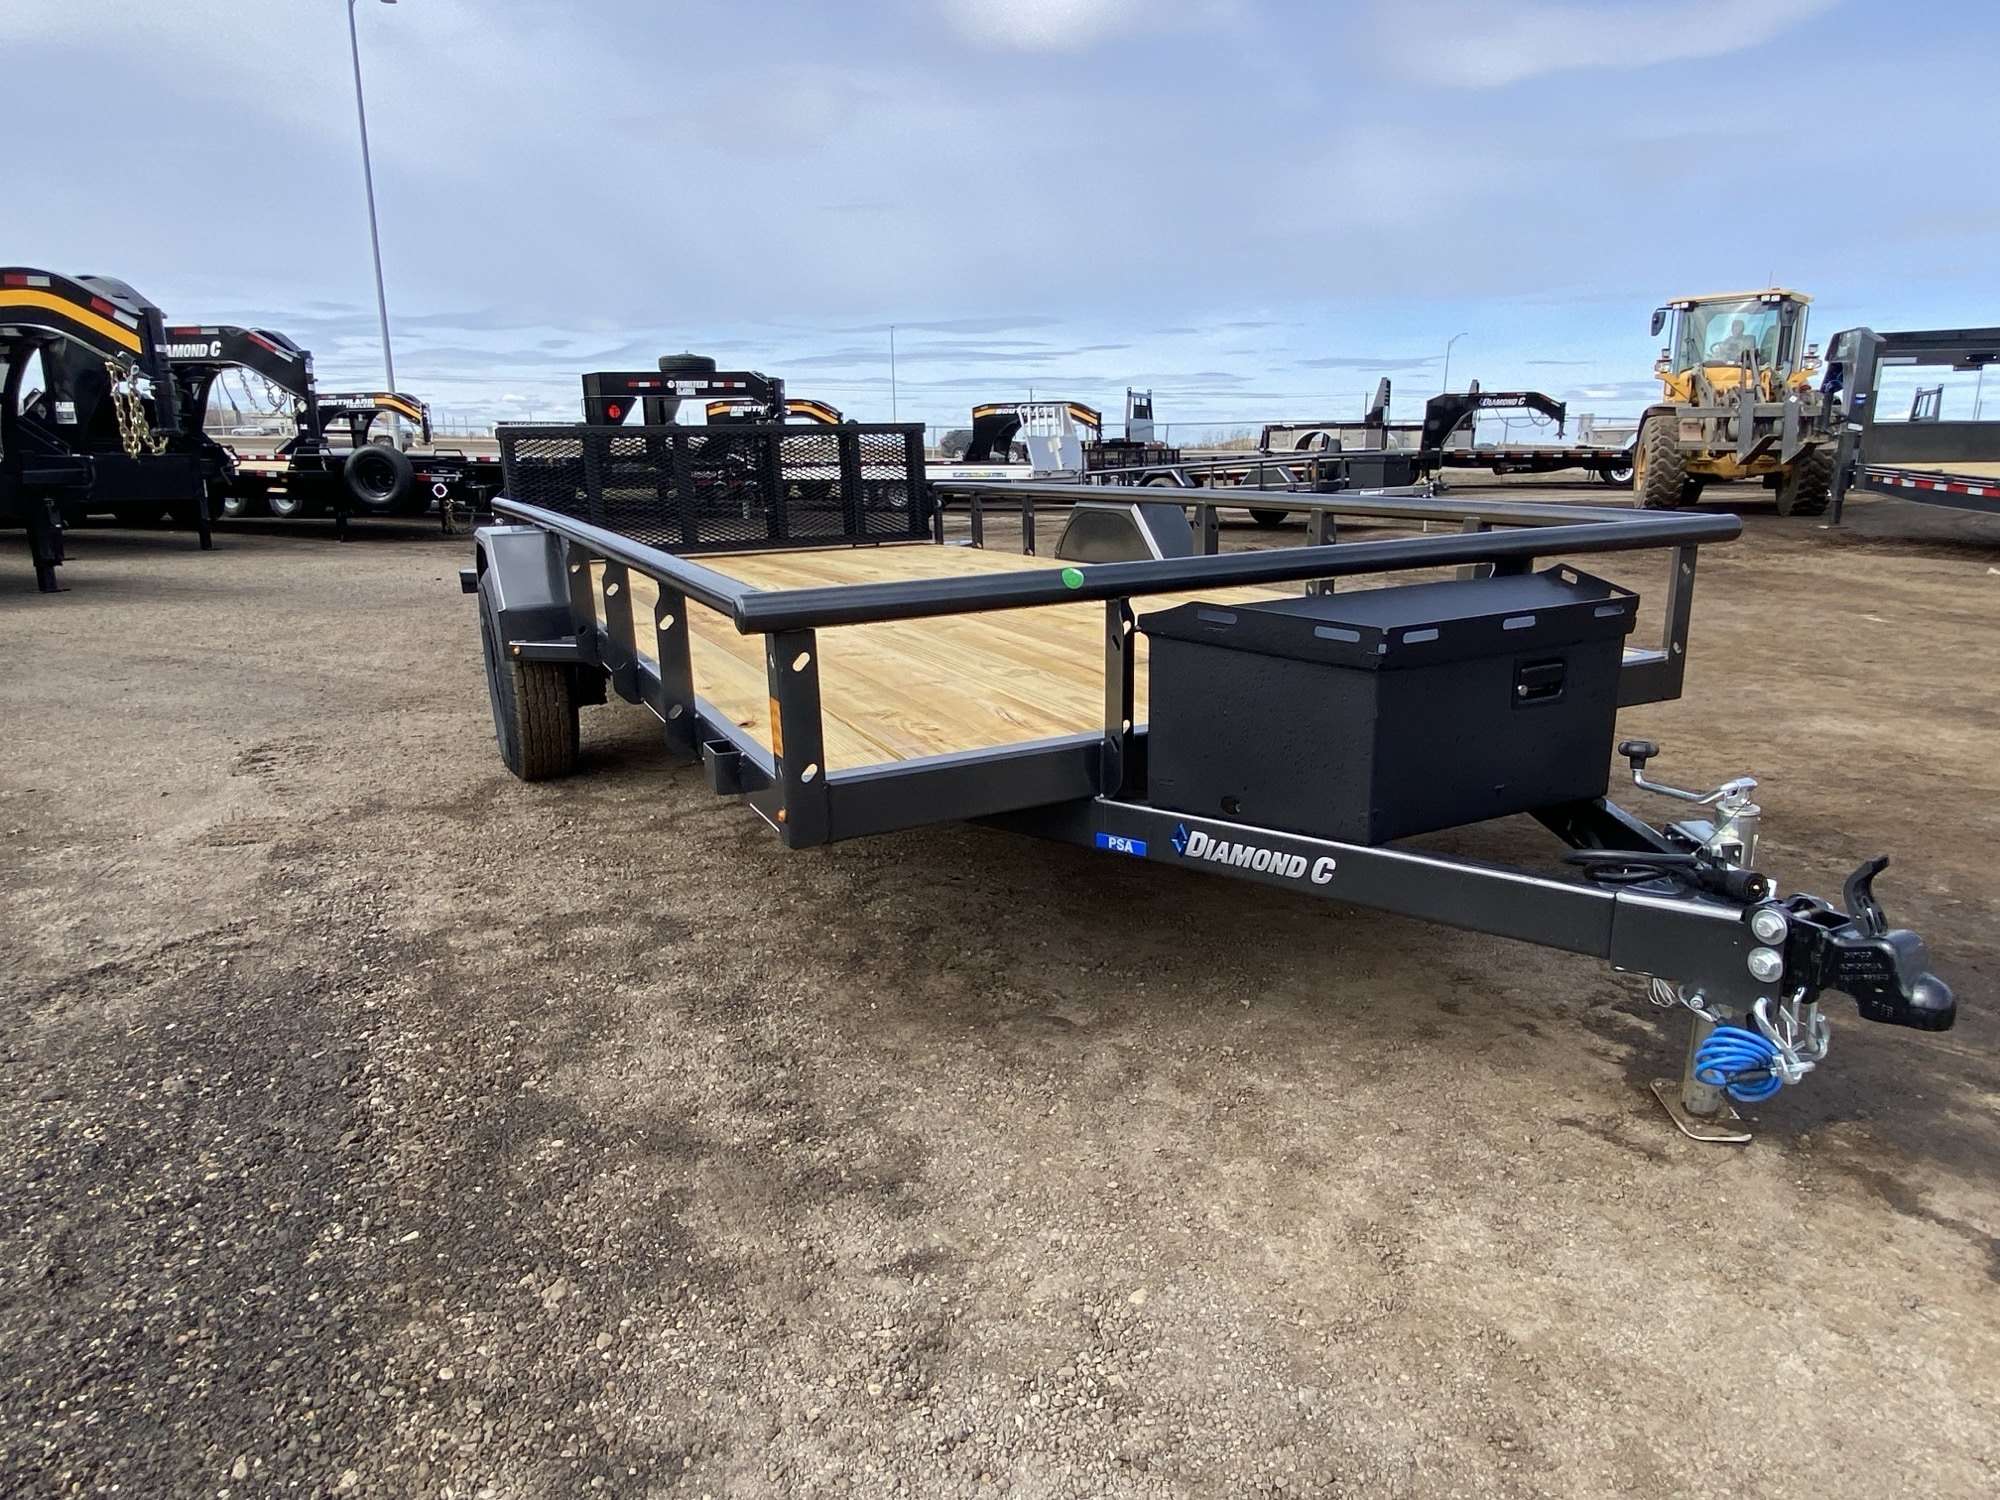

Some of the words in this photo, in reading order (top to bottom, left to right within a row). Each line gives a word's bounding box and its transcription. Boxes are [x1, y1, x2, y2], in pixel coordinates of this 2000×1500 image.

[166, 343, 208, 358] AMOND
[210, 340, 221, 357] C
[1483, 398, 1518, 406] DIAMOND
[1518, 397, 1526, 406] C
[1108, 836, 1134, 854] PSA
[1184, 830, 1308, 879] DIAMOND
[1310, 856, 1337, 885] C
